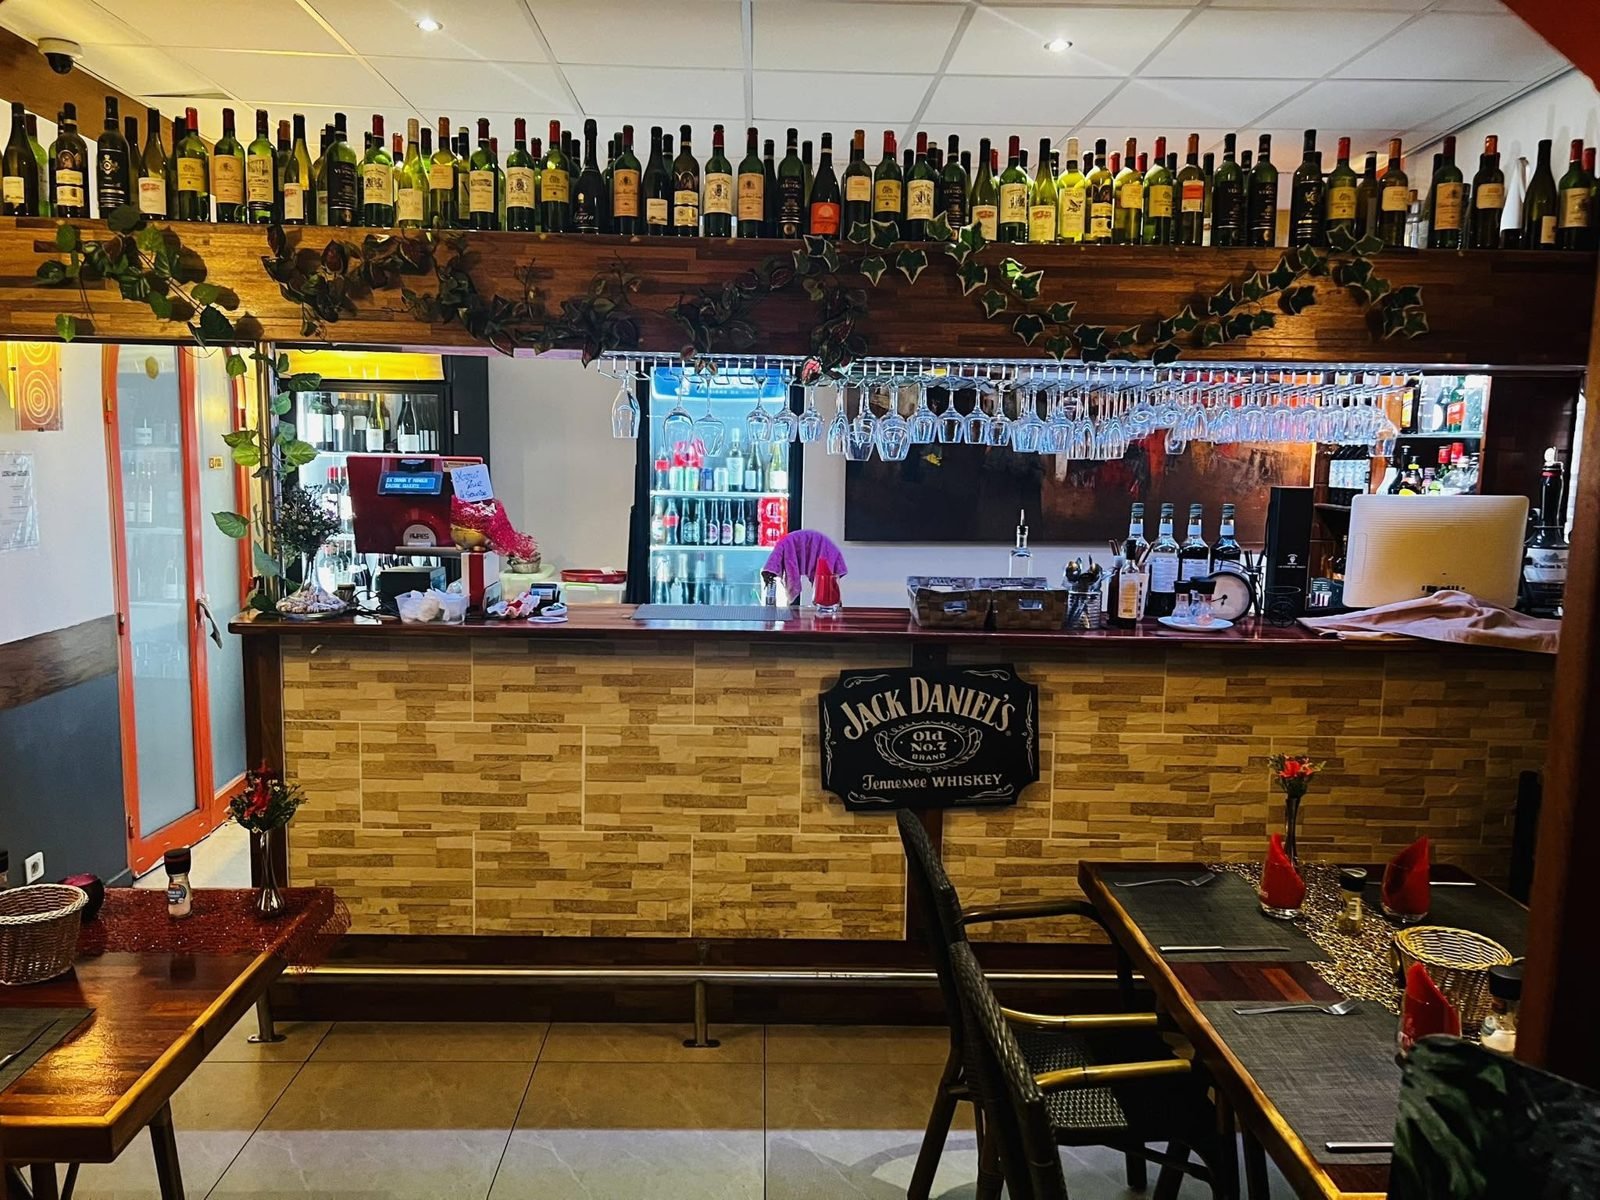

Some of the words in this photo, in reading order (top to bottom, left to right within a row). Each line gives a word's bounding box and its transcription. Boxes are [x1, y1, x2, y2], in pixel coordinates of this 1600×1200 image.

[840, 689, 907, 740] JACK
[909, 676, 1016, 732] DANIEL'S
[912, 730, 943, 742] Old
[911, 752, 947, 762] BRAND
[861, 774, 928, 792] Tennessee
[932, 773, 1003, 789] WHISKEY
